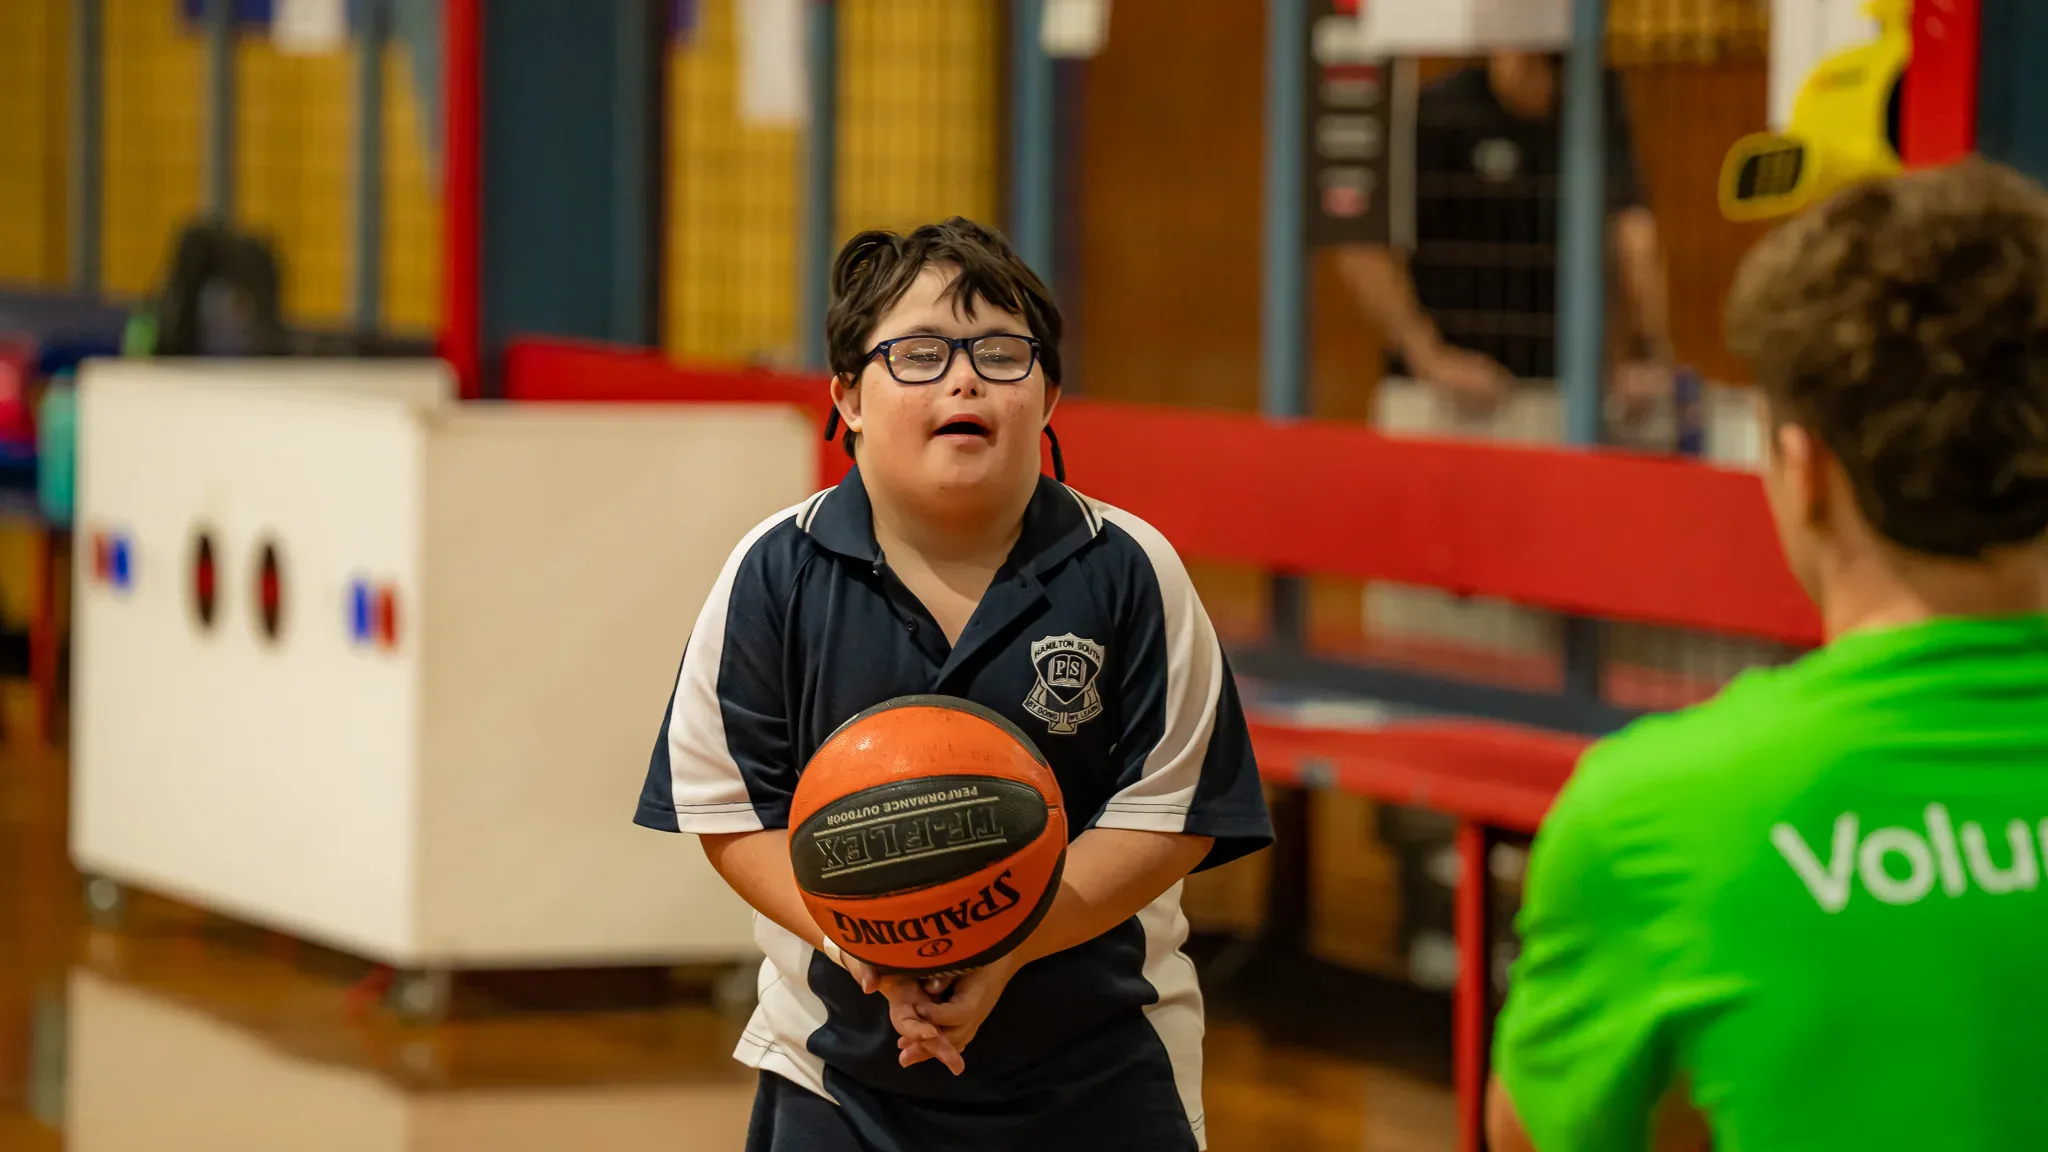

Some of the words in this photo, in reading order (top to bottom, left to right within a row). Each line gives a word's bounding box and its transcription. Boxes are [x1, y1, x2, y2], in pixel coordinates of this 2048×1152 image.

[1034, 640, 1073, 658] HAMILTON
[1078, 642, 1100, 662] SOUTH
[827, 804, 881, 826] OUTDOOR
[883, 785, 978, 813] PERFORMANCE
[815, 805, 1005, 872] TF-FLEX
[1769, 802, 2048, 914] Volu
[831, 869, 1020, 945] SPALDING
